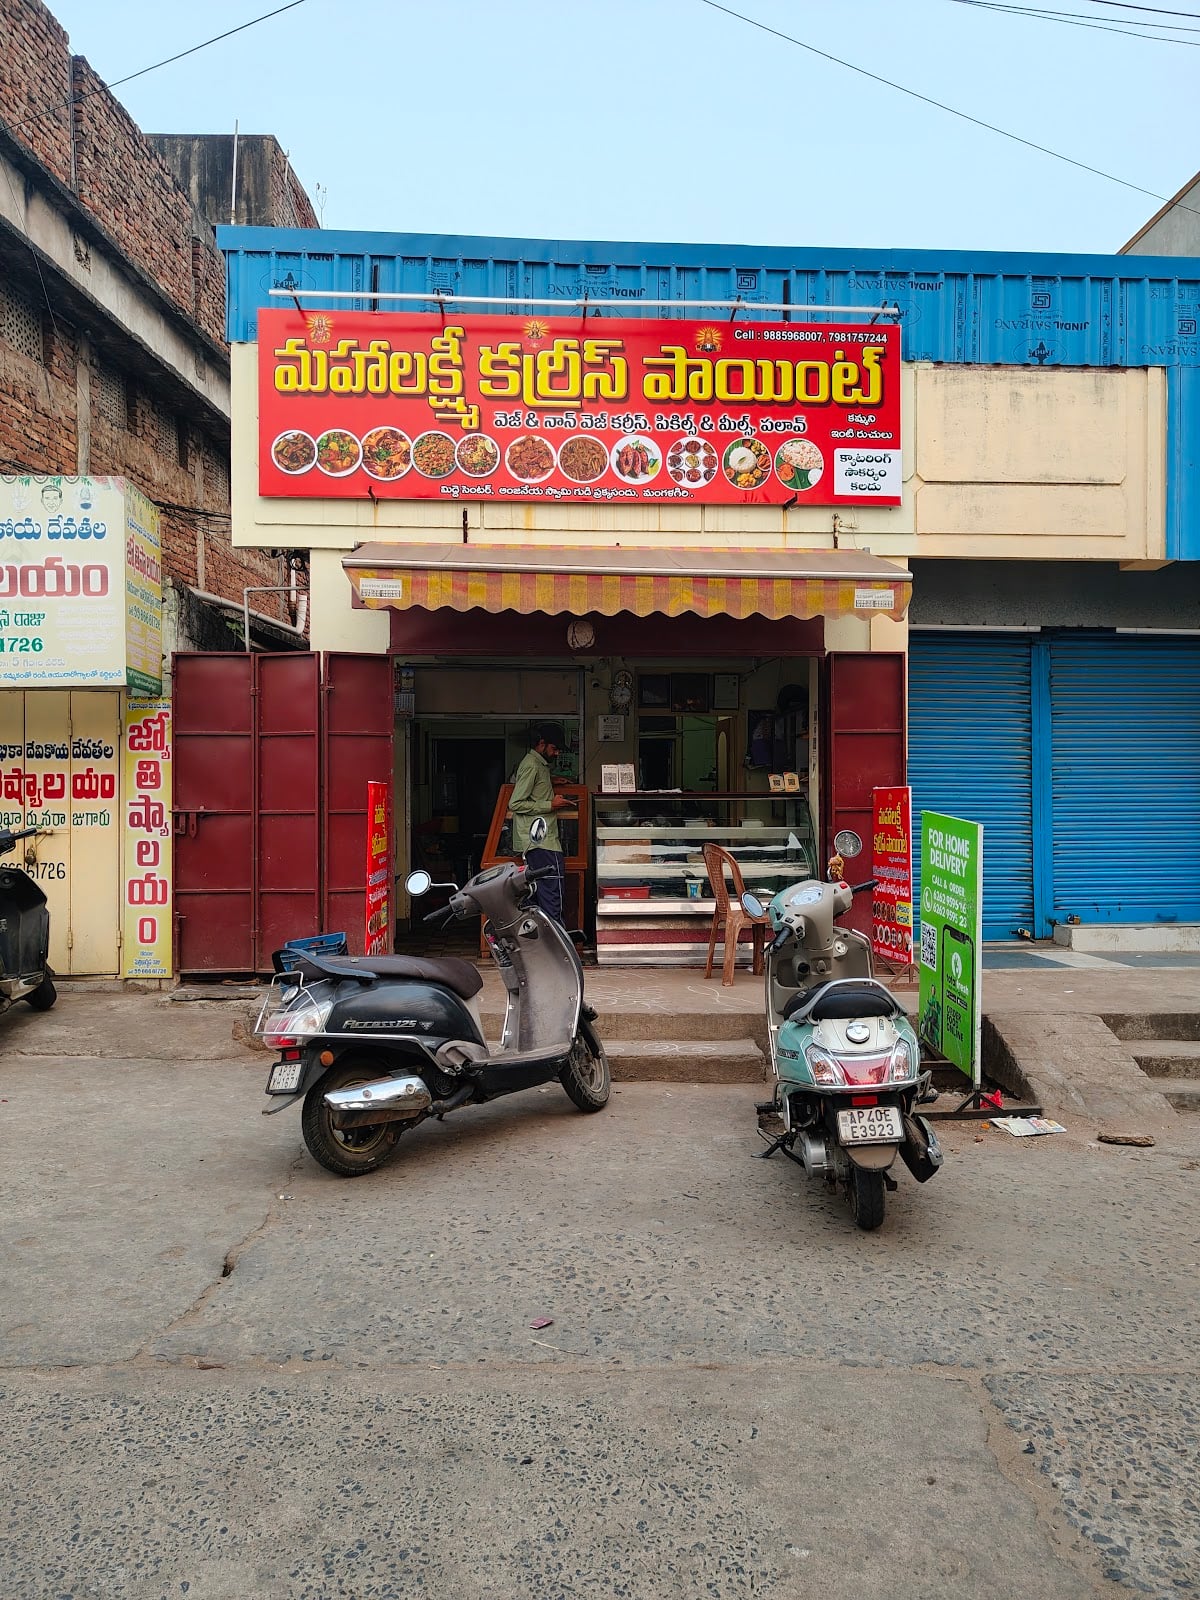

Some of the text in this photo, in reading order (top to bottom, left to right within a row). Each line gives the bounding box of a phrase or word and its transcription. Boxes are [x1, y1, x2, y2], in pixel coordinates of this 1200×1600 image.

[609, 287, 646, 298] JINDAL
[734, 330, 754, 340] Cell
[763, 330, 826, 343] 9885968007,
[829, 332, 888, 343] 7981757244
[274, 326, 886, 430] మహాలక్ష్మీ కర్రీస్ పాయింట్
[494, 412, 522, 428] వెజ్
[525, 413, 539, 427] &
[544, 414, 576, 429] నాన్
[581, 414, 607, 429] వెజ్
[701, 418, 714, 431] &
[760, 417, 808, 433] పలావ్
[847, 414, 876, 426] కమ్మని
[856, 430, 893, 439] రుచులు
[574, 488, 592, 497] గుడి
[850, 482, 882, 491] కలదు
[47, 515, 107, 541] దేవతల
[72, 738, 114, 759] దేవతల
[928, 828, 970, 859] FOR HOME
[930, 847, 968, 878] DELIVERY
[932, 874, 943, 888] CALL
[949, 882, 965, 897] ORDER
[851, 1124, 895, 1138] E3923
